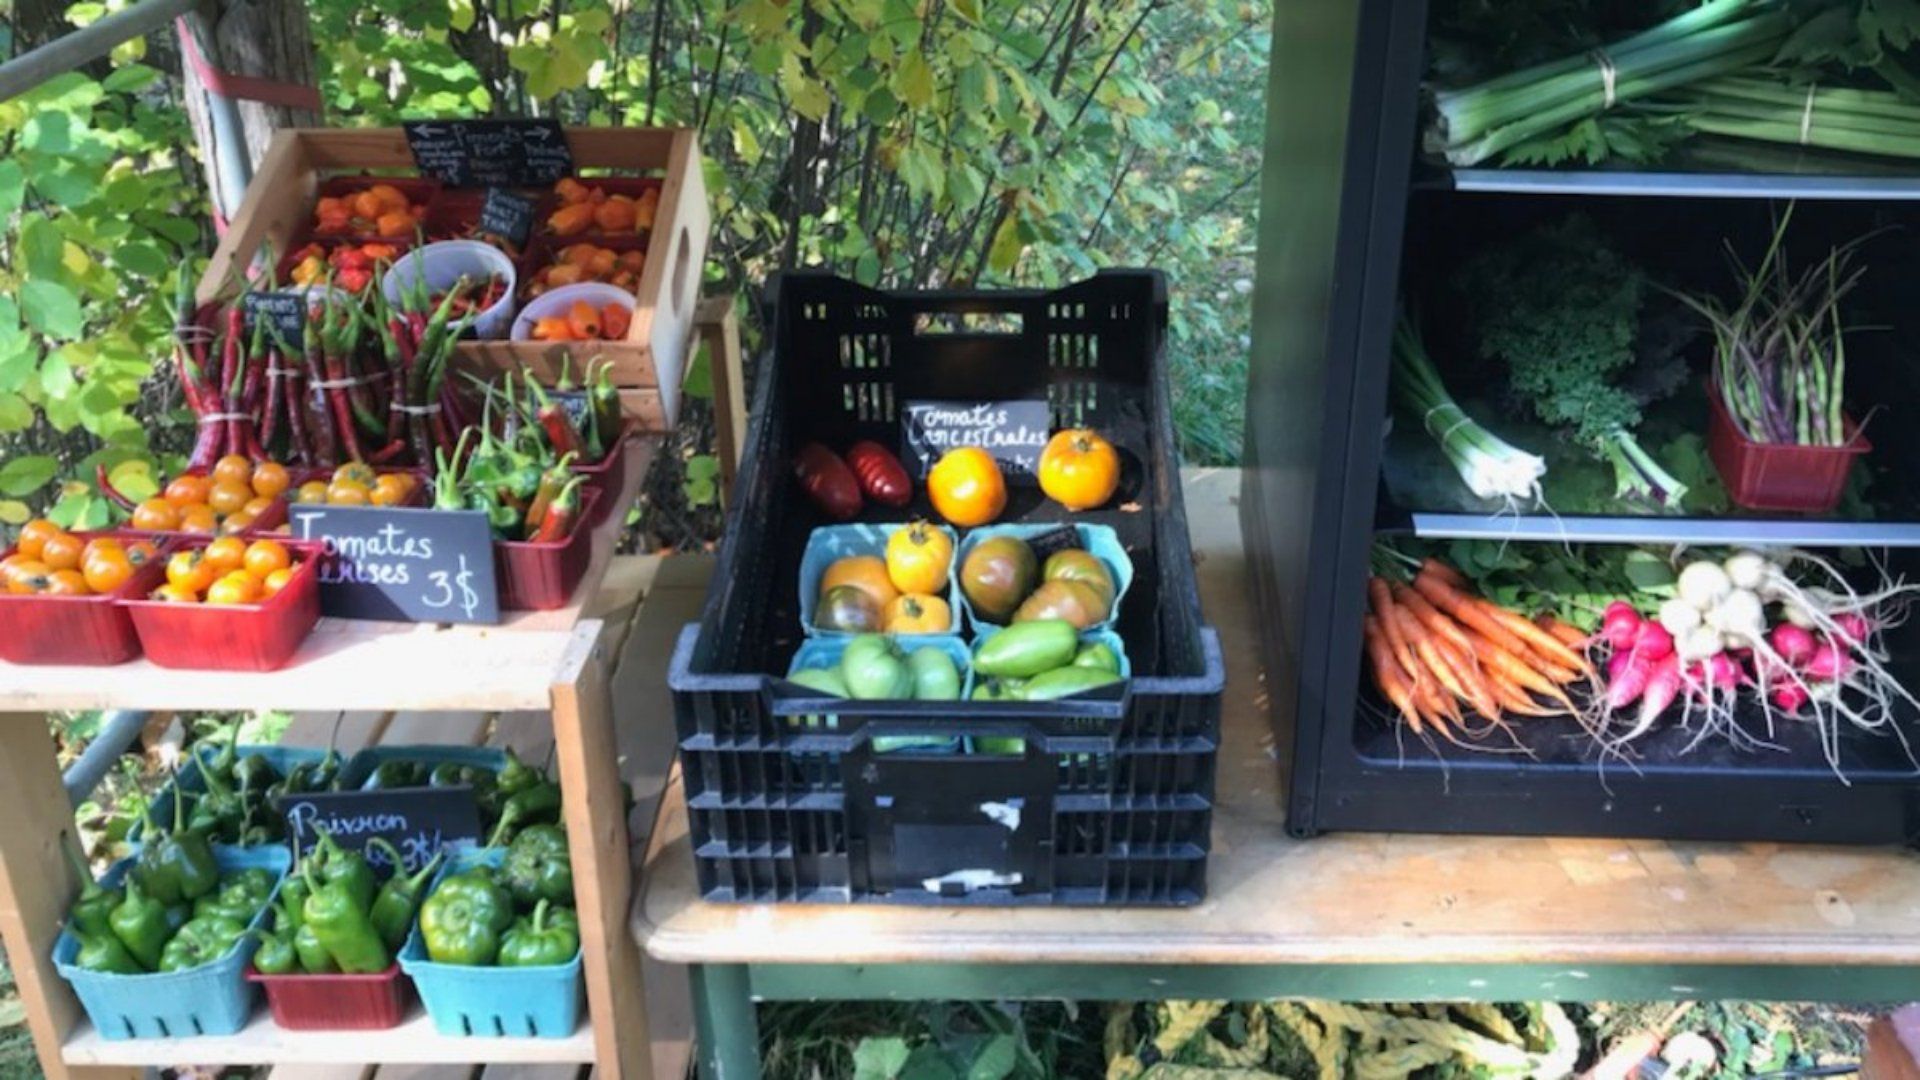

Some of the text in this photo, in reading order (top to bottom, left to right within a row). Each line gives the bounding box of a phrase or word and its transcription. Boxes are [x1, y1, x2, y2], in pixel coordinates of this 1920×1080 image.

[908, 403, 1009, 438] Tomates
[295, 511, 433, 560] Tomates
[317, 559, 410, 585] erises
